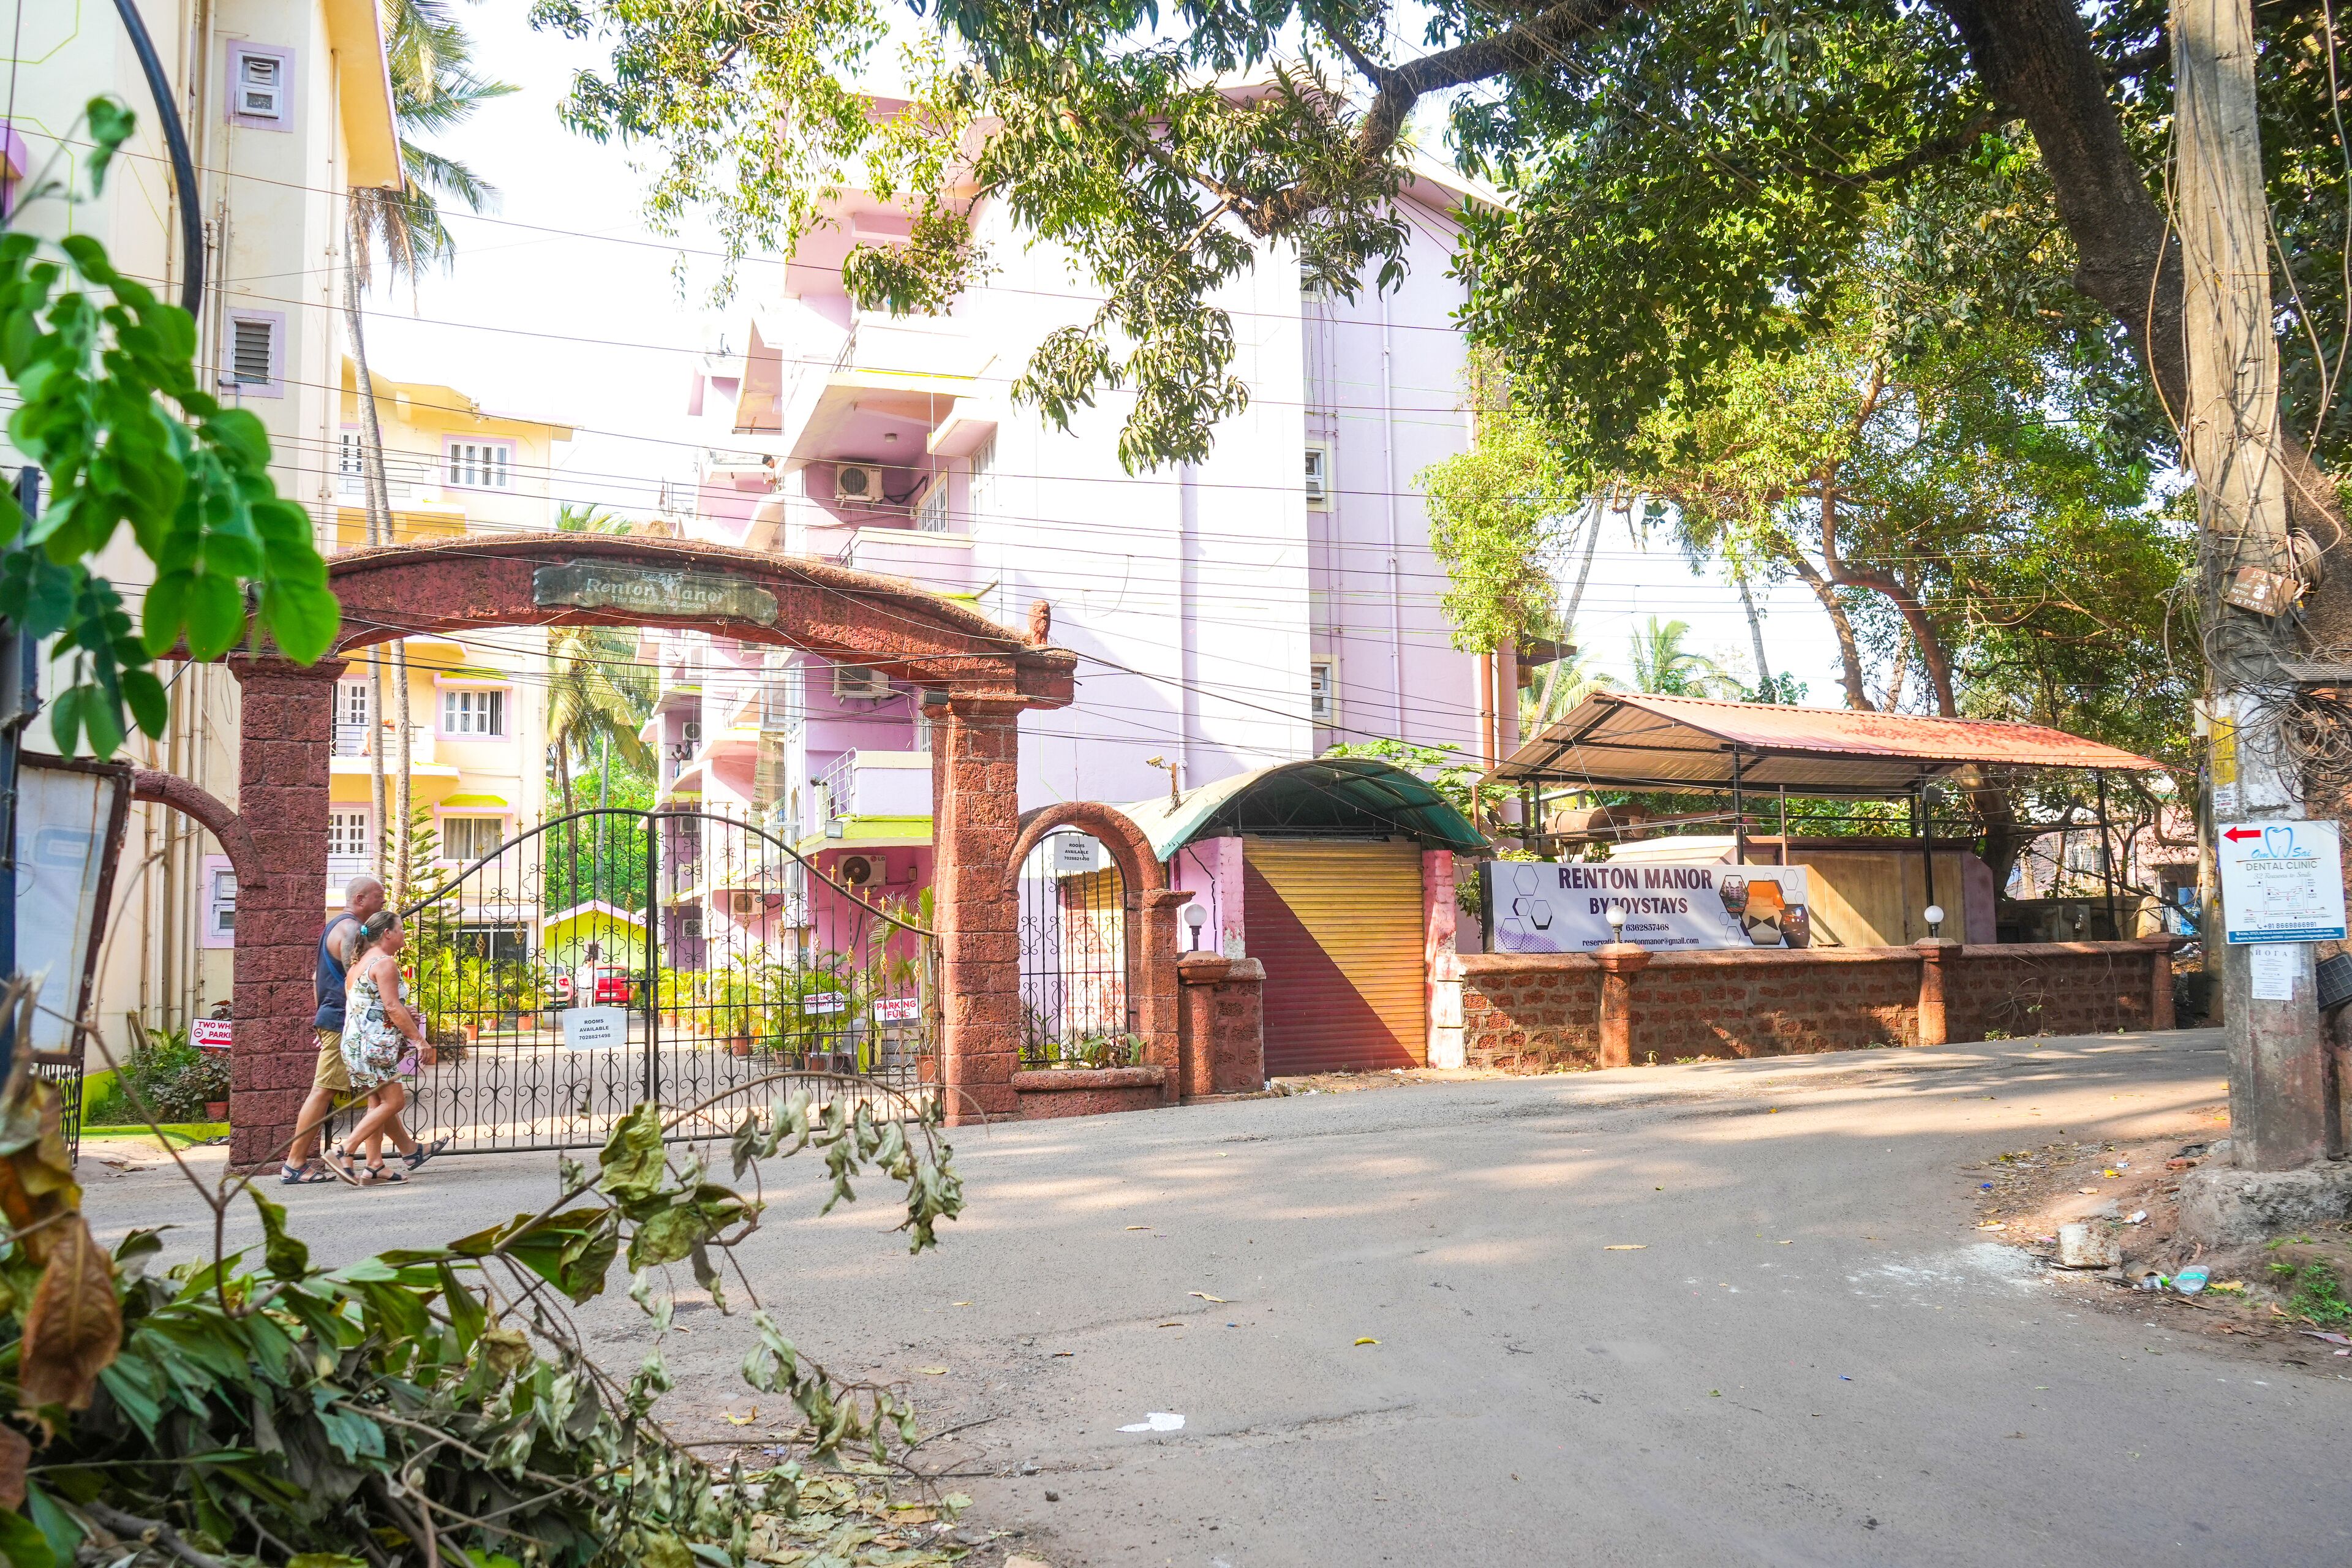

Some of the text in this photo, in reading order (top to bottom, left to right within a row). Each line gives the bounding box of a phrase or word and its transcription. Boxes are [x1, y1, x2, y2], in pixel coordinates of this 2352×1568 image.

[586, 578, 727, 602] Renton Manor
[681, 601, 707, 609] Resort
[2251, 847, 2312, 859] Om Sai
[2245, 861, 2318, 871] DENTAL CLINIC
[1558, 868, 1713, 889] RENTON MANOR
[1589, 897, 1610, 914] BY
[1582, 937, 1699, 946] reservatiosrentonmanor@gmail.com
[2255, 948, 2288, 957] ЙОГА
[876, 1000, 916, 1010] PARKNG
